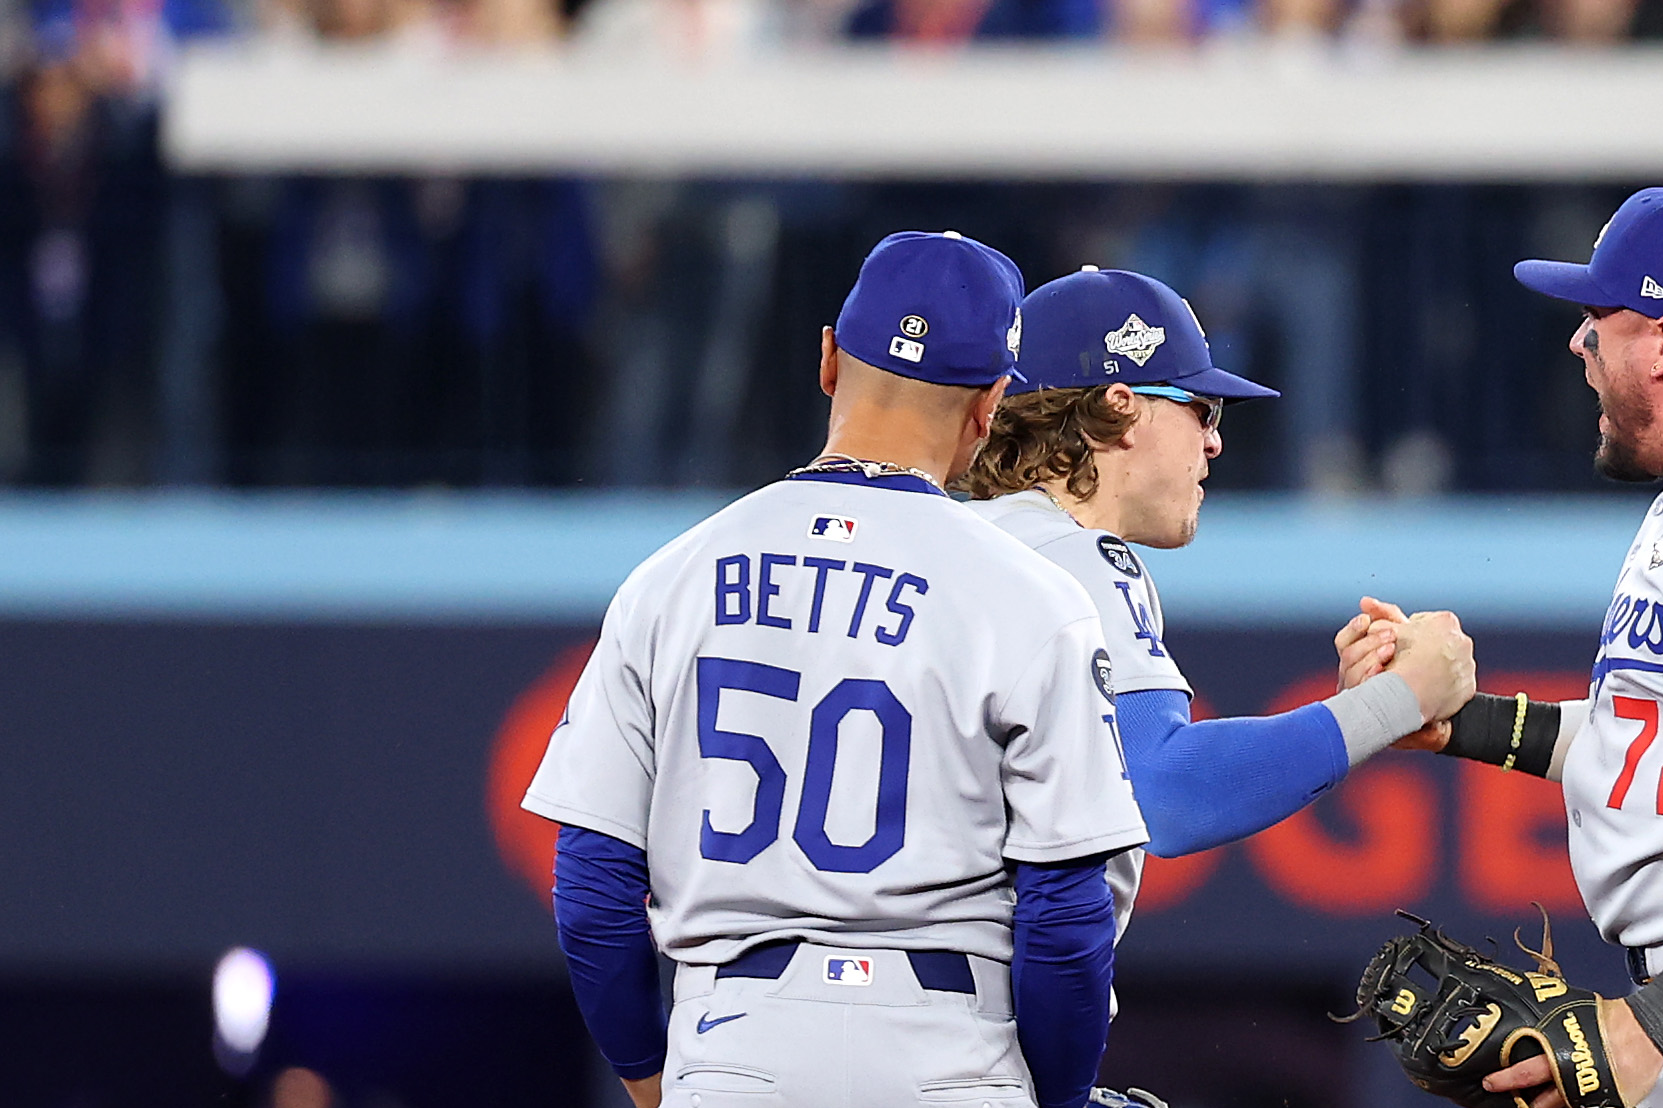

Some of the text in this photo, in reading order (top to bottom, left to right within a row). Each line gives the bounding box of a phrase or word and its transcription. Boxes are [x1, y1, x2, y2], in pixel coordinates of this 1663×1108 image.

[905, 317, 923, 335] 21
[1103, 360, 1119, 375] 51
[715, 553, 930, 647] BETTS
[1113, 580, 1165, 658] LA
[696, 656, 913, 874] 50
[1562, 1014, 1601, 1097] Wilson
